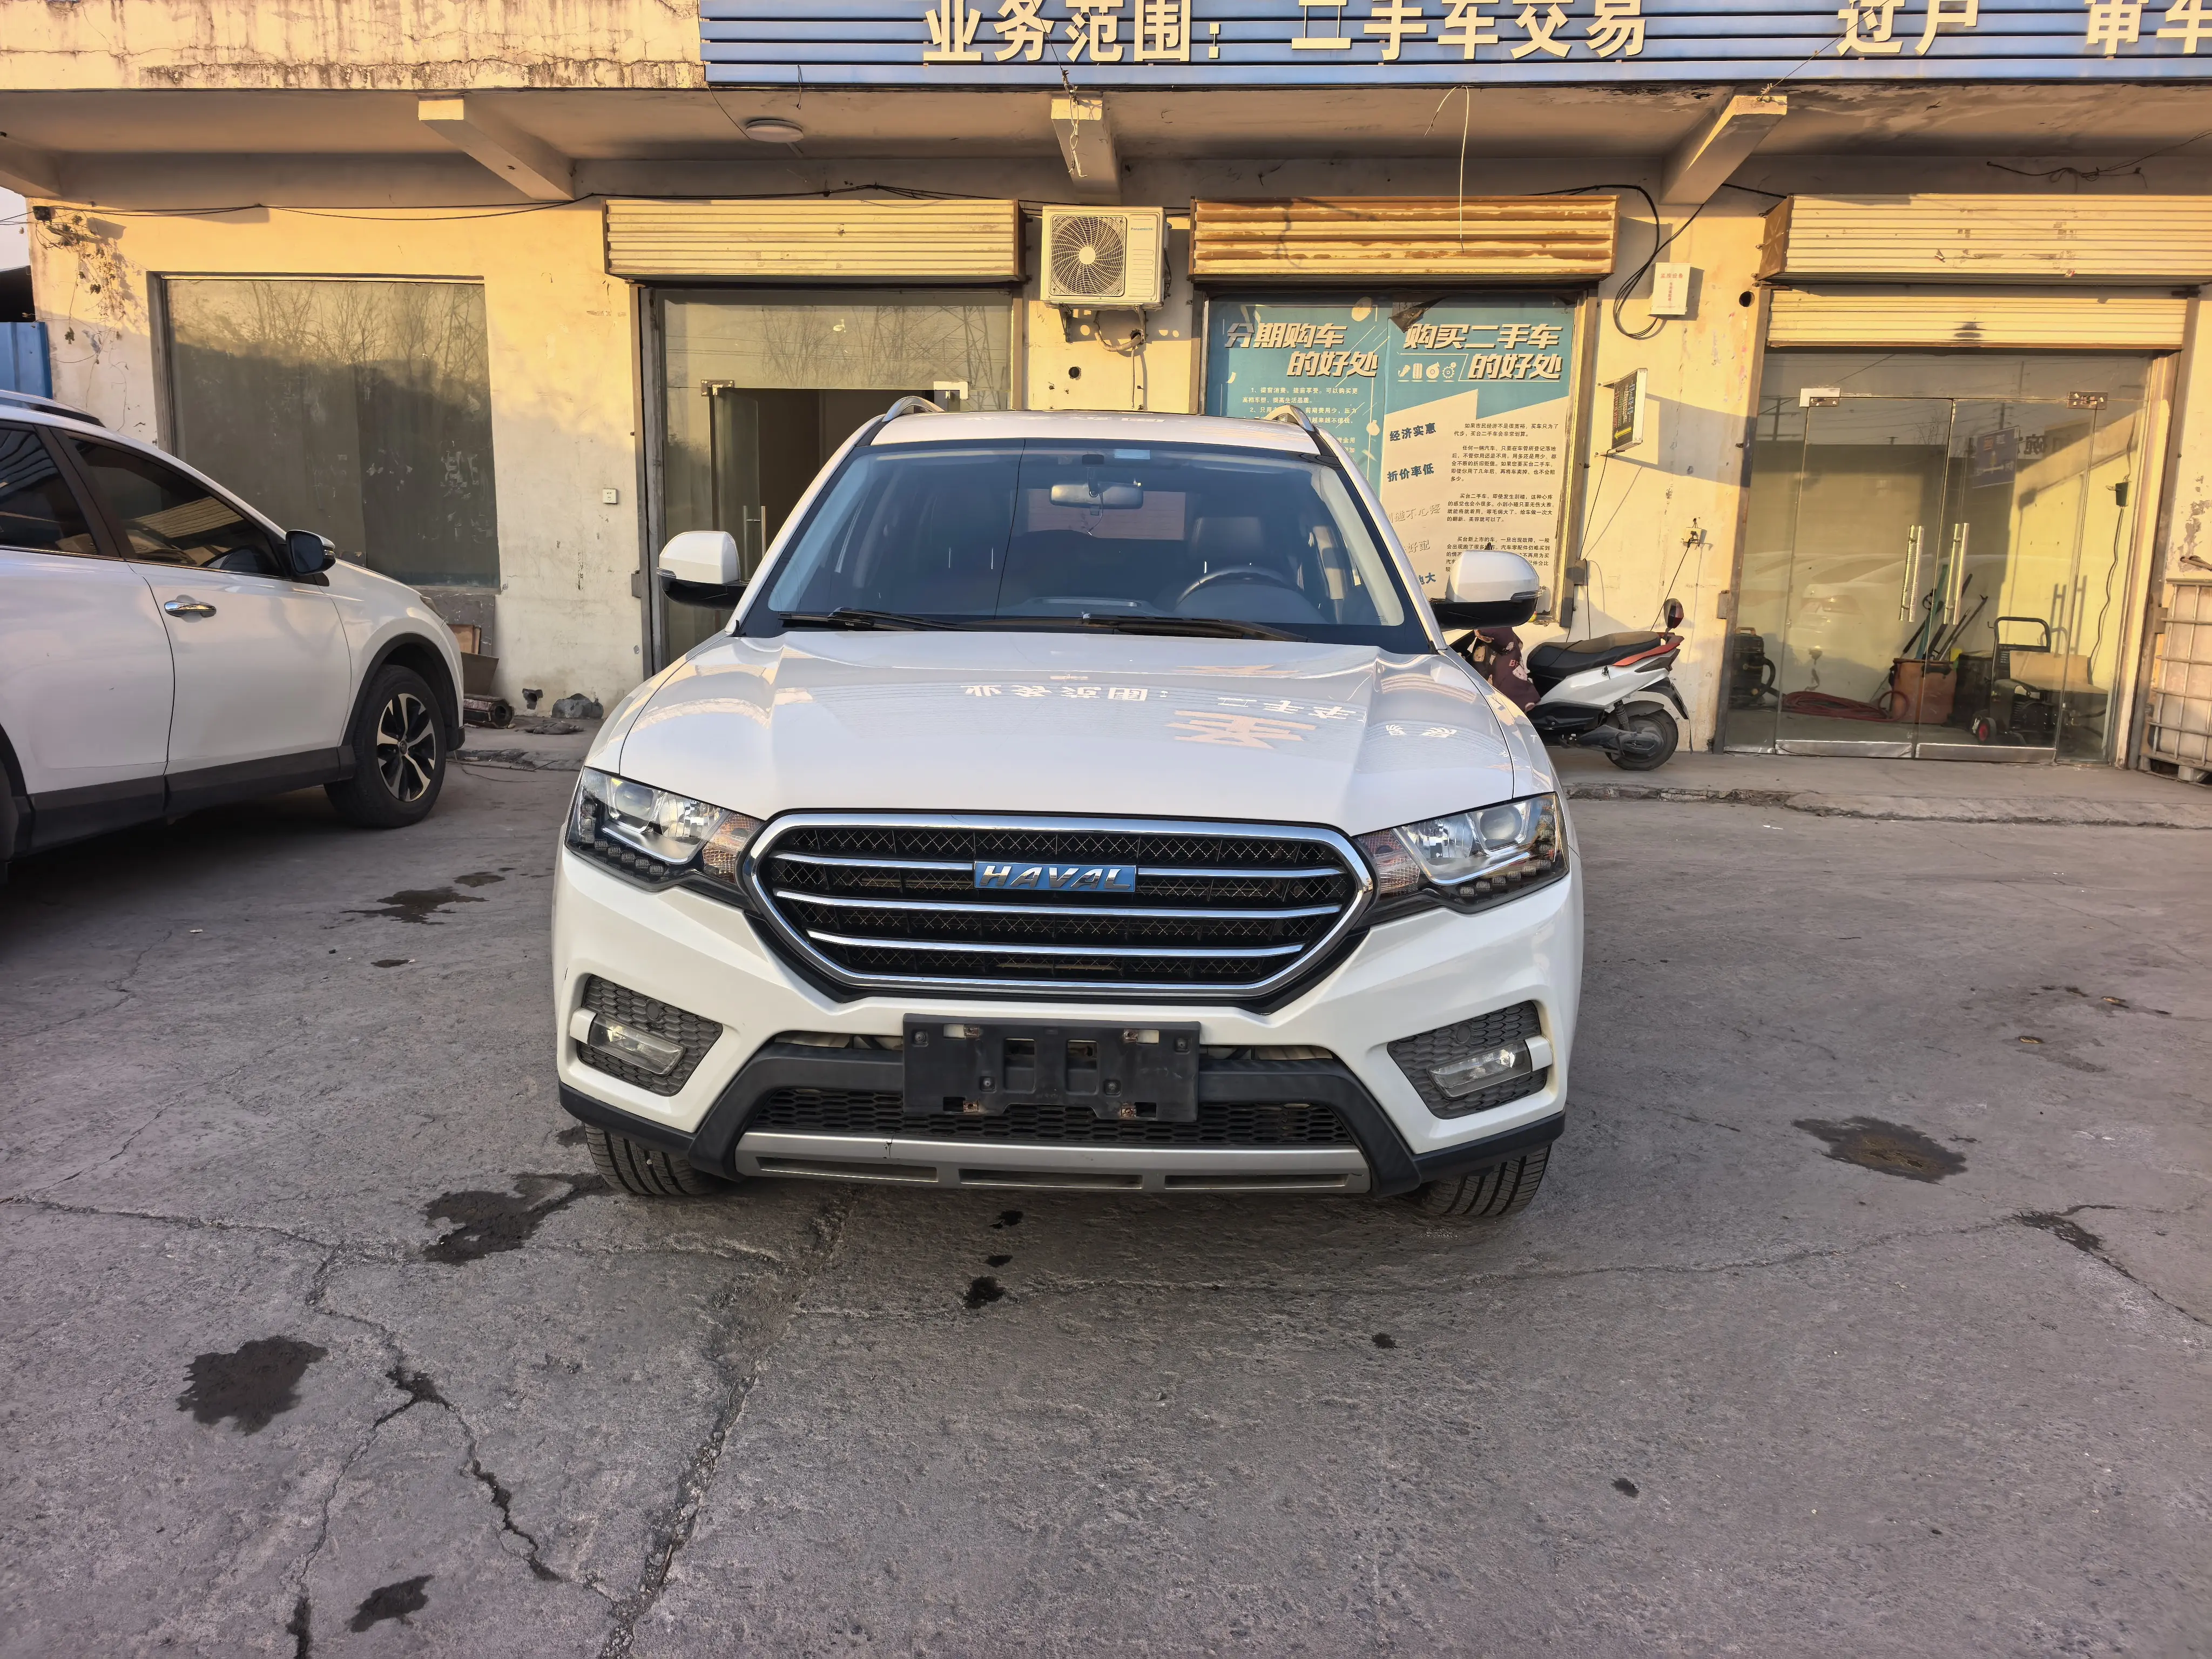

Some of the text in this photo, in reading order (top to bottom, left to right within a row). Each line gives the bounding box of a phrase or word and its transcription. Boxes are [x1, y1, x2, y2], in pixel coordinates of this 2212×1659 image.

[1224, 322, 1347, 349] 分期购车
[1403, 323, 1563, 349] 购买二手车
[1286, 350, 1379, 377] 的好处
[1467, 353, 1562, 380] 的好处
[1389, 422, 1437, 442] 经济实惠
[1387, 463, 1434, 482] 折价率低
[1404, 539, 1430, 554] 好配
[979, 865, 1131, 890] HAVAL
